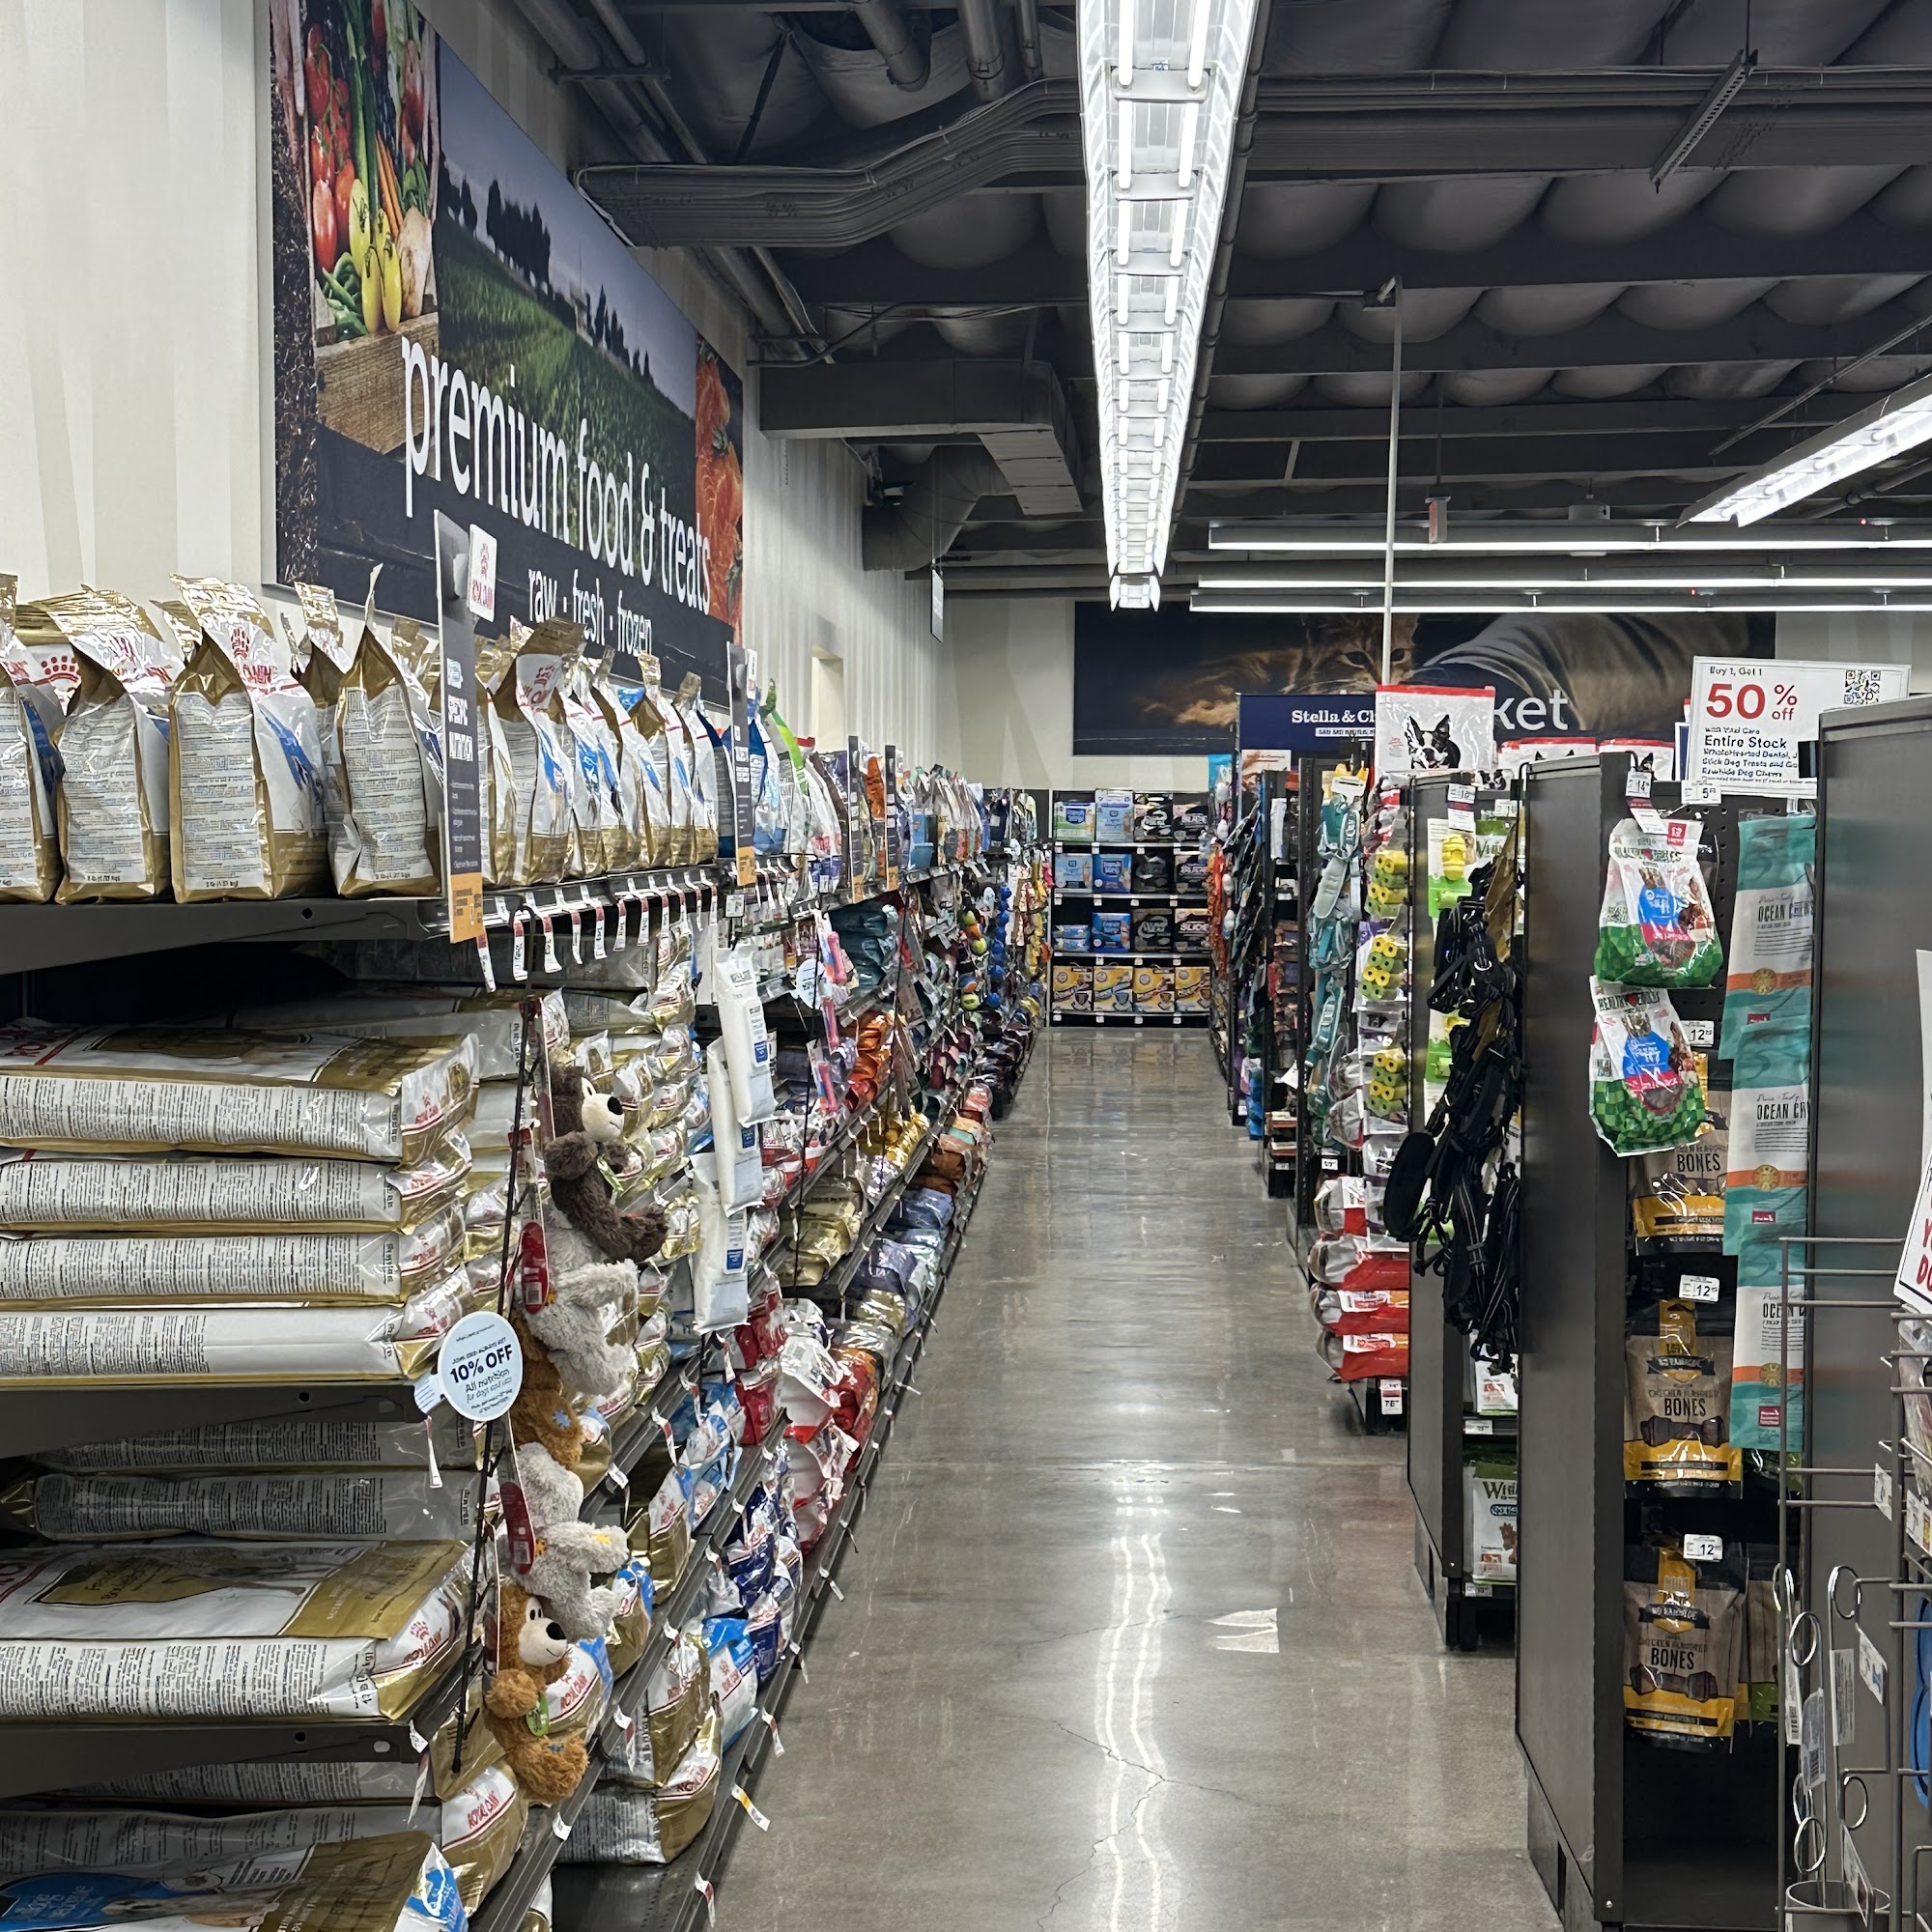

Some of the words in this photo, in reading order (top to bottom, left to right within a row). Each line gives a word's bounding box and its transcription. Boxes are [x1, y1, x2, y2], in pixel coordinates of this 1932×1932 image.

[401, 335, 570, 544] premium
[578, 418, 634, 577] food
[641, 462, 656, 586] &
[660, 487, 711, 615] treats
[528, 569, 557, 623] raw
[573, 569, 605, 645] fresh
[617, 589, 652, 657] frozen
[1706, 683, 1766, 720] 50
[1291, 709, 1340, 724] Stella
[1342, 709, 1356, 724] &
[1772, 708, 1794, 720] off
[1704, 734, 1744, 748] Entire
[1748, 736, 1787, 749] Stock
[1758, 903, 1786, 923] OCEAN
[1757, 1103, 1789, 1121] OCEAN
[1677, 1152, 1721, 1173] BONES
[1762, 1302, 1794, 1319] OCEN
[449, 1357, 485, 1383] 10%
[485, 1344, 513, 1369] OFF
[1663, 1398, 1706, 1417] BONES
[1651, 1647, 1695, 1670] BONES
